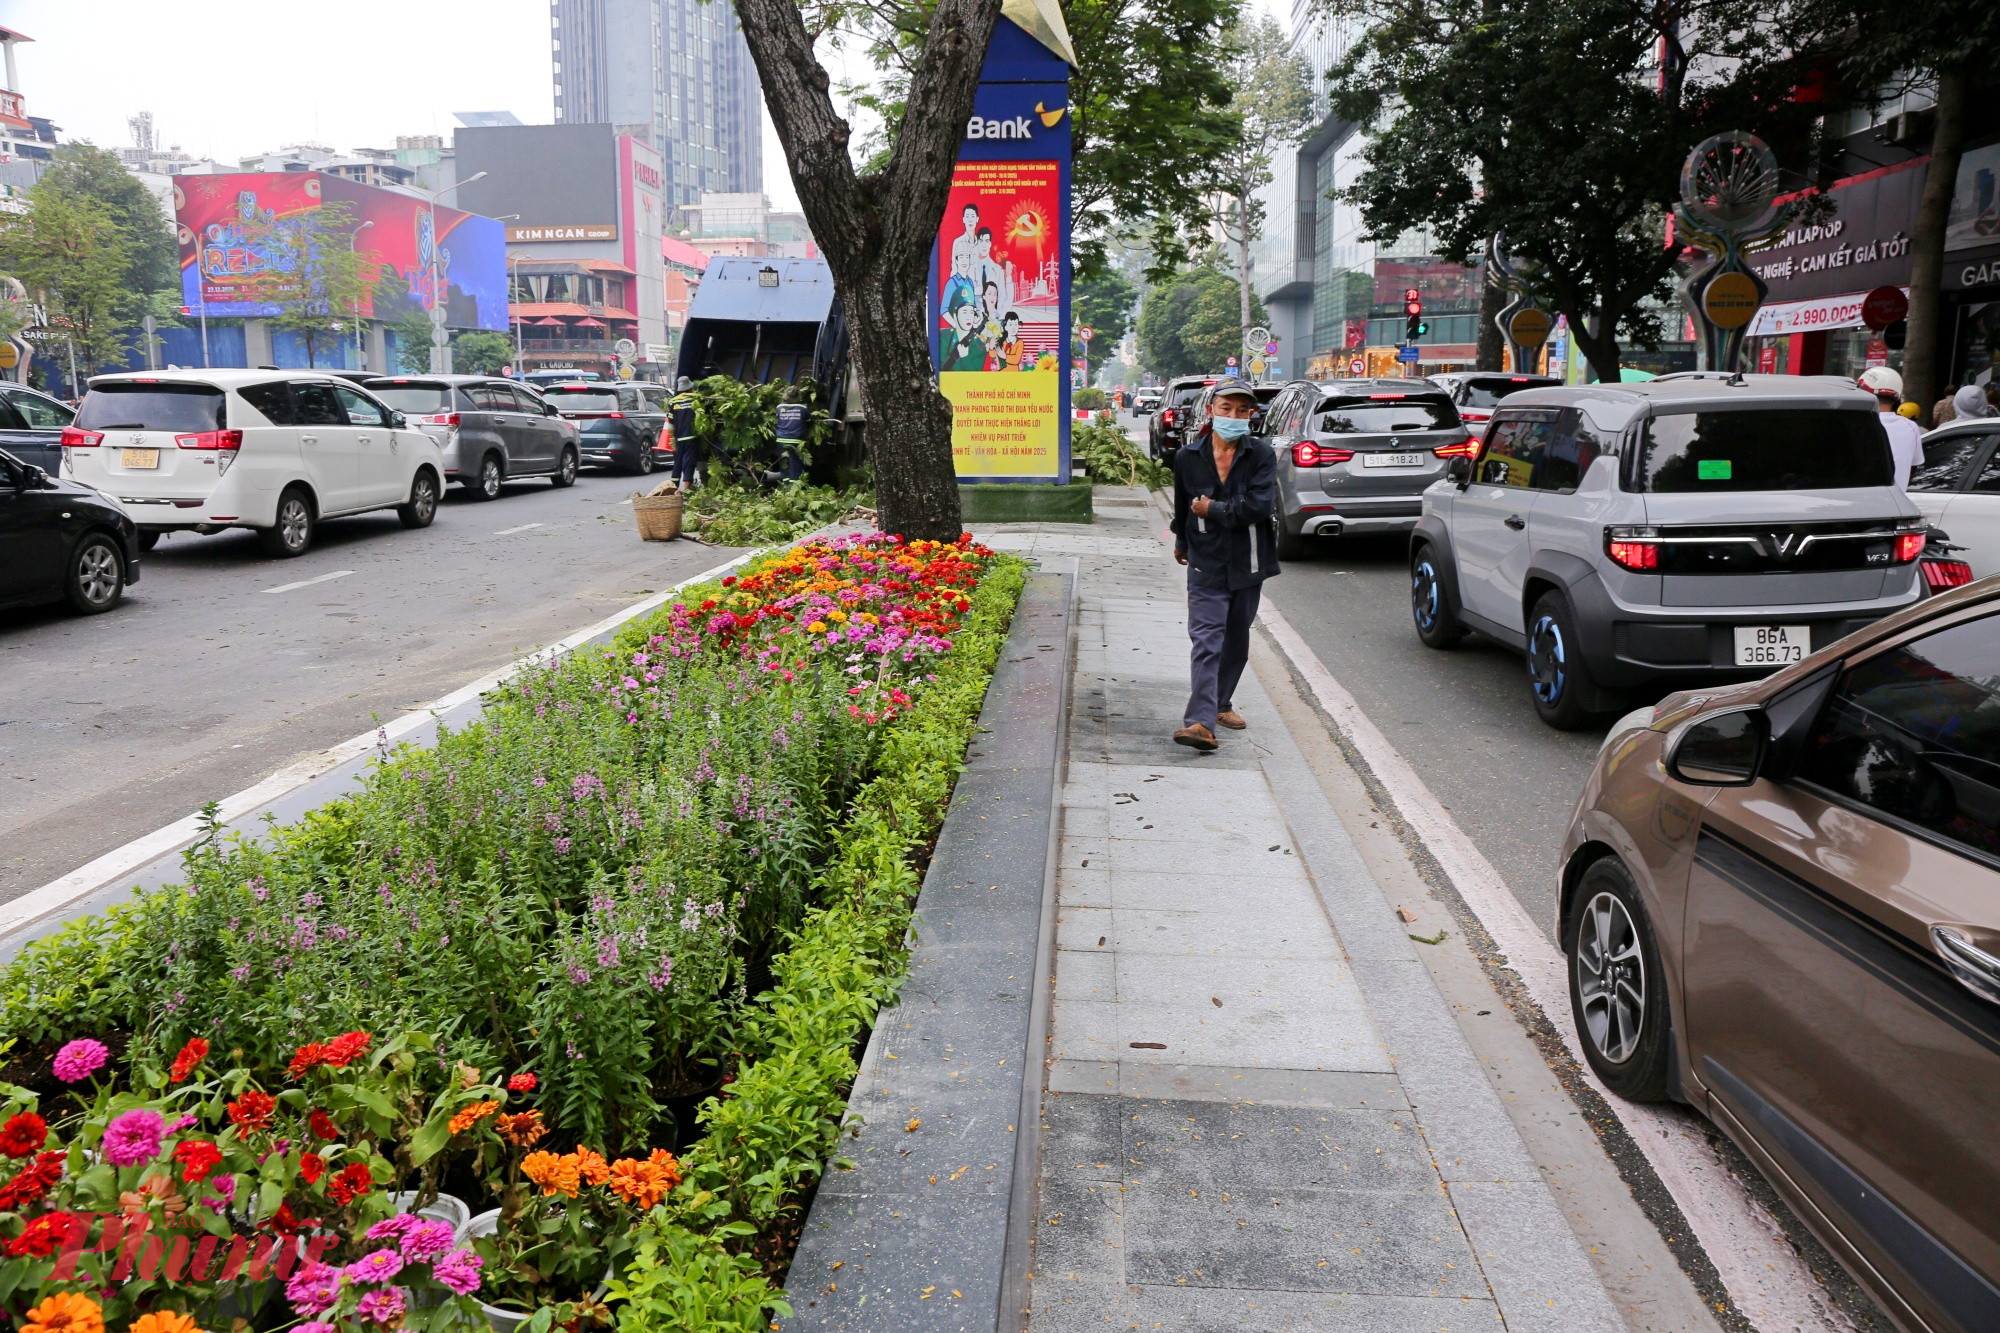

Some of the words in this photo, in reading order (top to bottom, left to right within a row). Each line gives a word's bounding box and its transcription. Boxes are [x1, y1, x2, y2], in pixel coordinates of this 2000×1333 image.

[967, 116, 1032, 138] Bank
[516, 230, 542, 239] KIM
[545, 228, 584, 238] NGAN
[1797, 220, 1842, 244] LAPTOP
[1764, 256, 1792, 280] NGHỆ
[1801, 254, 1826, 273] CAM
[1828, 242, 1852, 268] KẾT
[1855, 240, 1876, 263] GIÁ
[1881, 232, 1908, 258] TỐT
[966, 389, 983, 398] THÀNH
[985, 389, 996, 398] PHỐ
[998, 389, 1004, 398] HỒ
[1006, 389, 1015, 398] CHÍ
[991, 403, 1004, 413] TRÀO
[1028, 403, 1037, 413] YÊU
[1039, 403, 1053, 413] NƯỚC
[957, 417, 971, 427] QUYẾT
[974, 417, 983, 427] TÂM
[985, 420, 999, 429] THỰC
[1001, 417, 1012, 429] HIỆN
[1014, 417, 1031, 427] THẮNG
[1032, 419, 1040, 429] LỢI
[971, 432, 986, 442] NHIỆM
[988, 434, 995, 442] VỤ
[997, 432, 1010, 441] PHÁT
[1012, 432, 1026, 441] TRIỂN
[965, 445, 970, 455] TẾ
[975, 445, 985, 455] VĂN
[1002, 445, 1008, 455] XÃ
[1010, 445, 1019, 457] HỘI
[1021, 445, 1032, 455] NĂM
[124, 459, 153, 467] 046.77
[1757, 628, 1787, 644] 86A
[1744, 646, 1801, 662] 366.73
